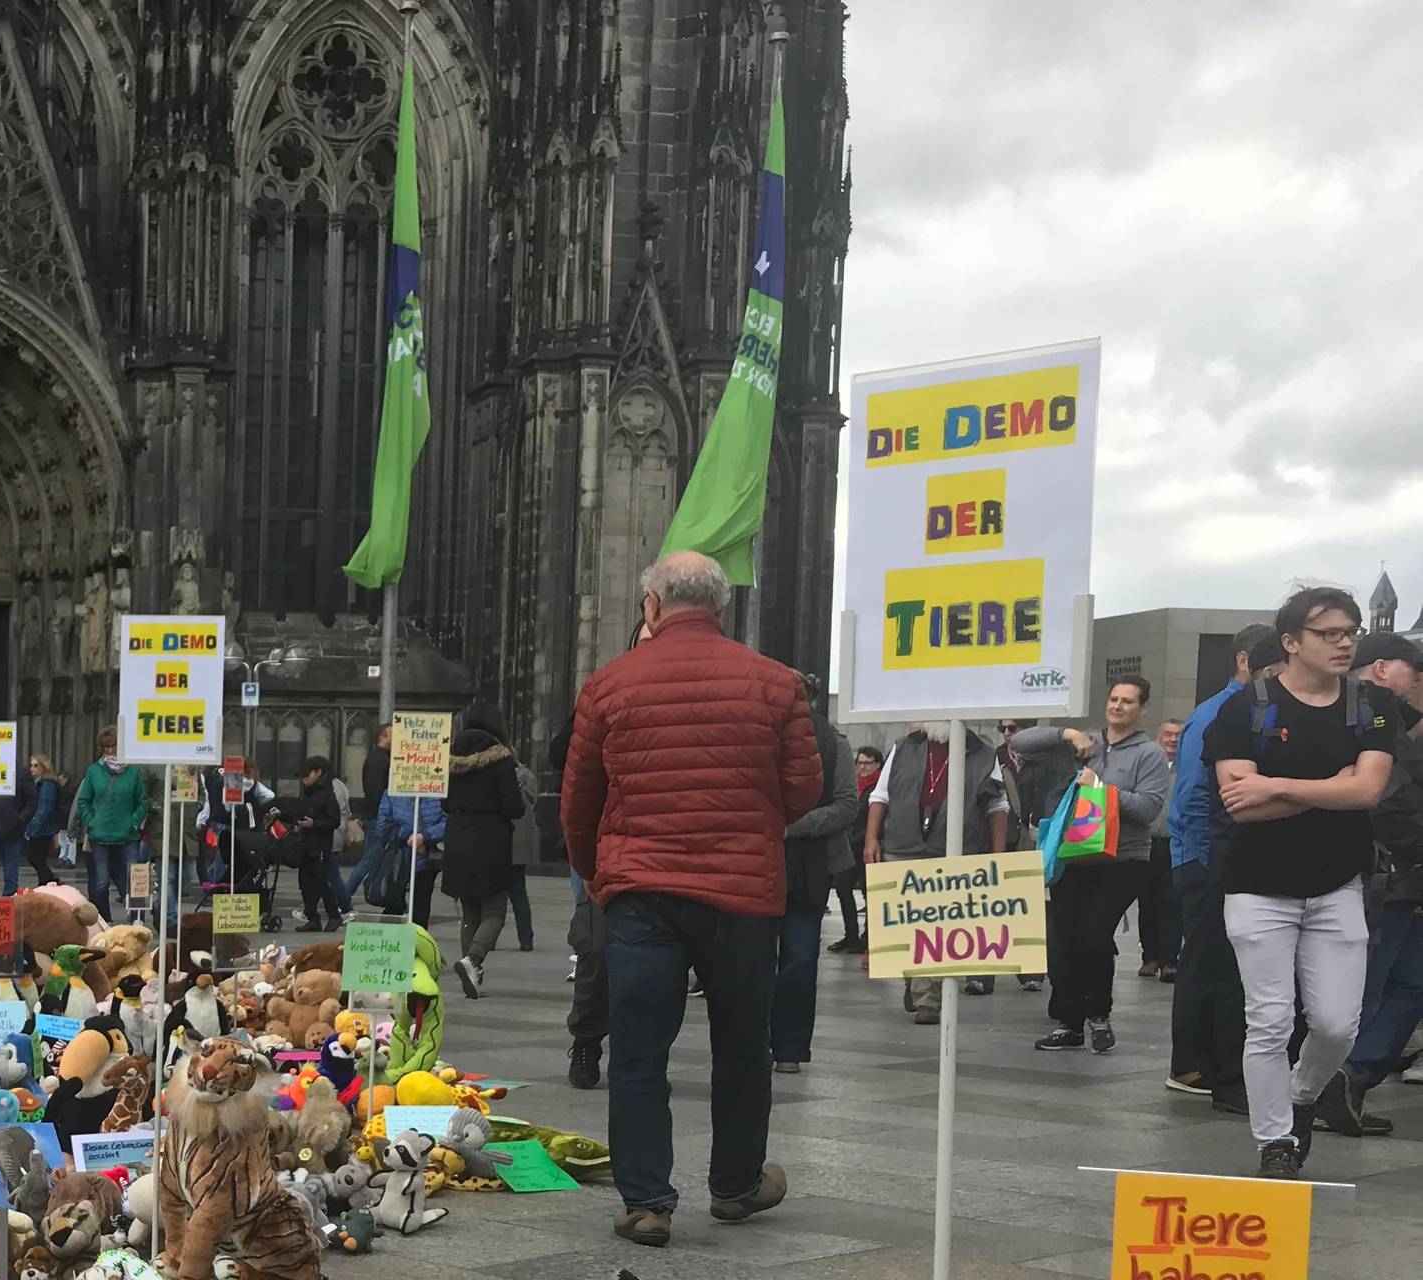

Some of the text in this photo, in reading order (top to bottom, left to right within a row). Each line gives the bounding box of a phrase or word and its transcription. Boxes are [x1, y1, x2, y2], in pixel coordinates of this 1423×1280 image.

[867, 395, 1076, 459] DIE DEMO
[927, 500, 1002, 540] DER
[887, 596, 1042, 657] TIERE
[129, 633, 217, 651] DIE DEMO
[155, 673, 188, 688] DER
[138, 712, 204, 736] TIERE
[404, 717, 425, 728] Pelz
[411, 729, 441, 739] Folter
[401, 740, 421, 751] Pelz
[900, 860, 999, 895] Animal
[883, 893, 1028, 927] Liberation
[913, 924, 1009, 964] NOW
[83, 1143, 109, 1152] Deine
[1141, 1196, 1267, 1247] Tiere
